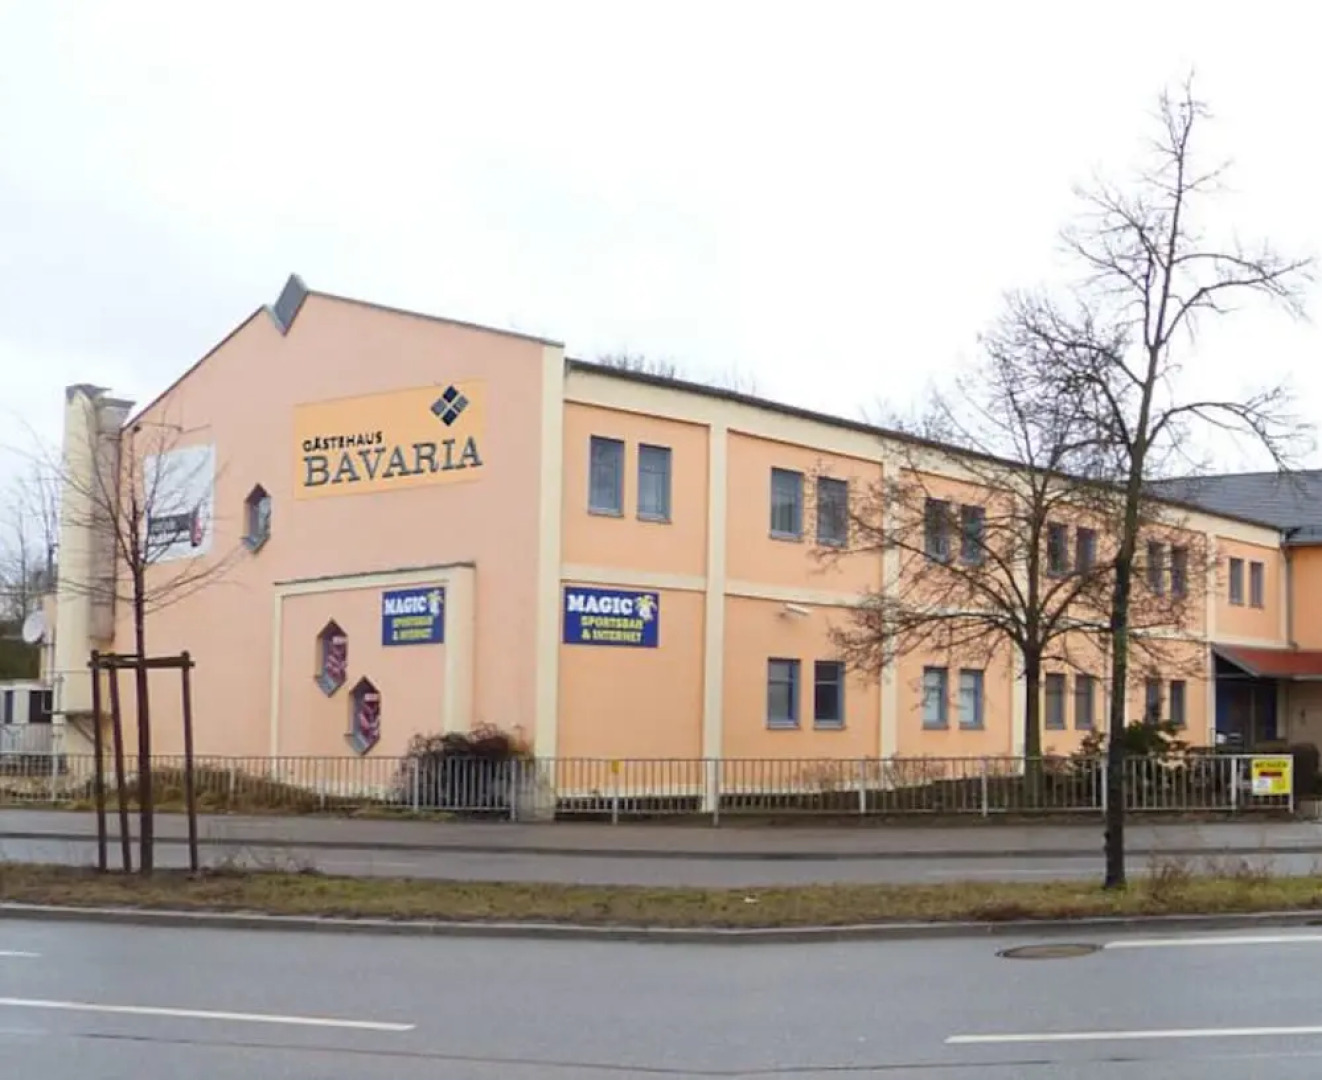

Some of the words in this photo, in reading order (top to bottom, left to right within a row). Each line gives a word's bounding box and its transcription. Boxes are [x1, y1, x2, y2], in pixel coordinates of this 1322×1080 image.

[302, 431, 383, 452] GÄSTEHAUS
[303, 436, 483, 487] BAVARIA
[384, 595, 428, 616] MAGIC
[567, 594, 634, 616] MAGIC
